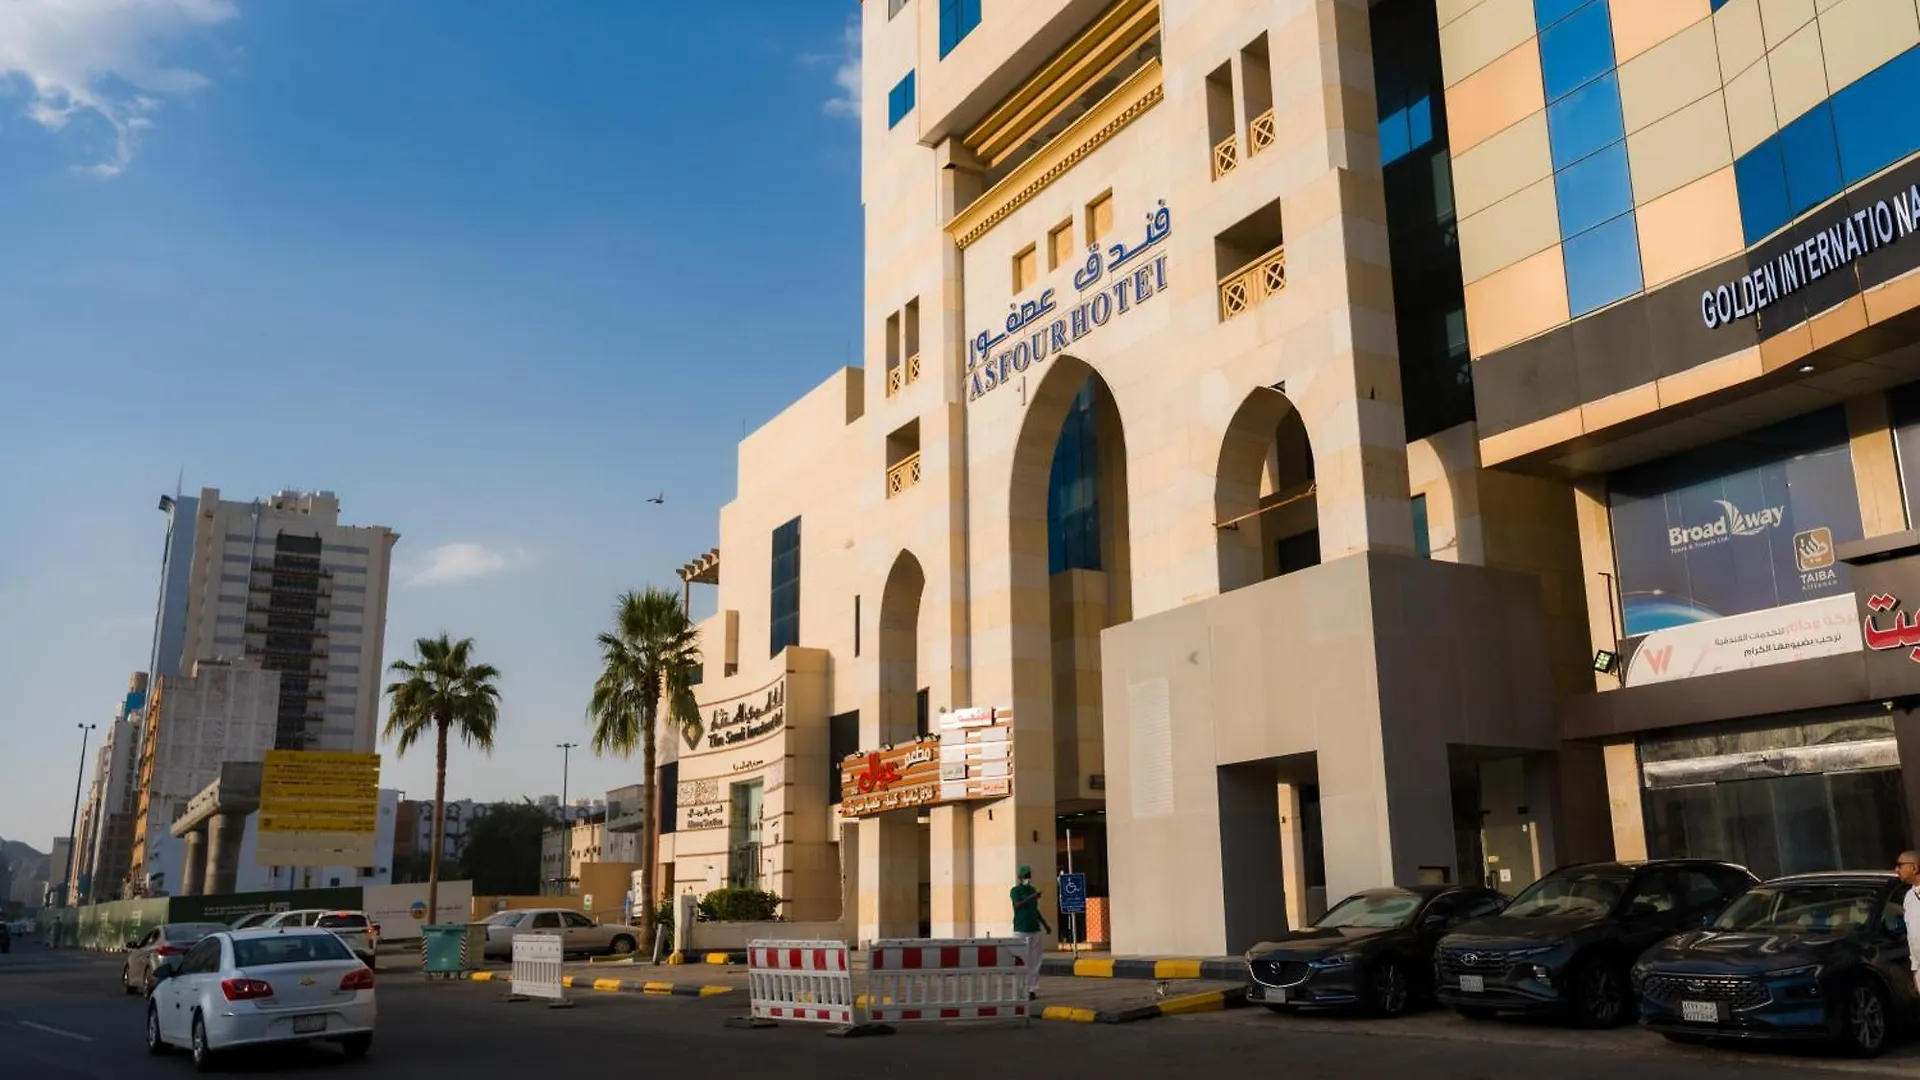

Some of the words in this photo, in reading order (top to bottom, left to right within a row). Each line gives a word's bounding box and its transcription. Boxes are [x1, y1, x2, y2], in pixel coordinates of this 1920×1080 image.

[1074, 198, 1171, 292] فندق
[968, 287, 1057, 369] عصفور
[1701, 261, 1779, 329] GOLDEN
[968, 319, 1068, 402] ASFOUR
[1800, 568, 1836, 584] TAIBA
[1743, 643, 1771, 657] الكرام
[707, 733, 725, 748] The
